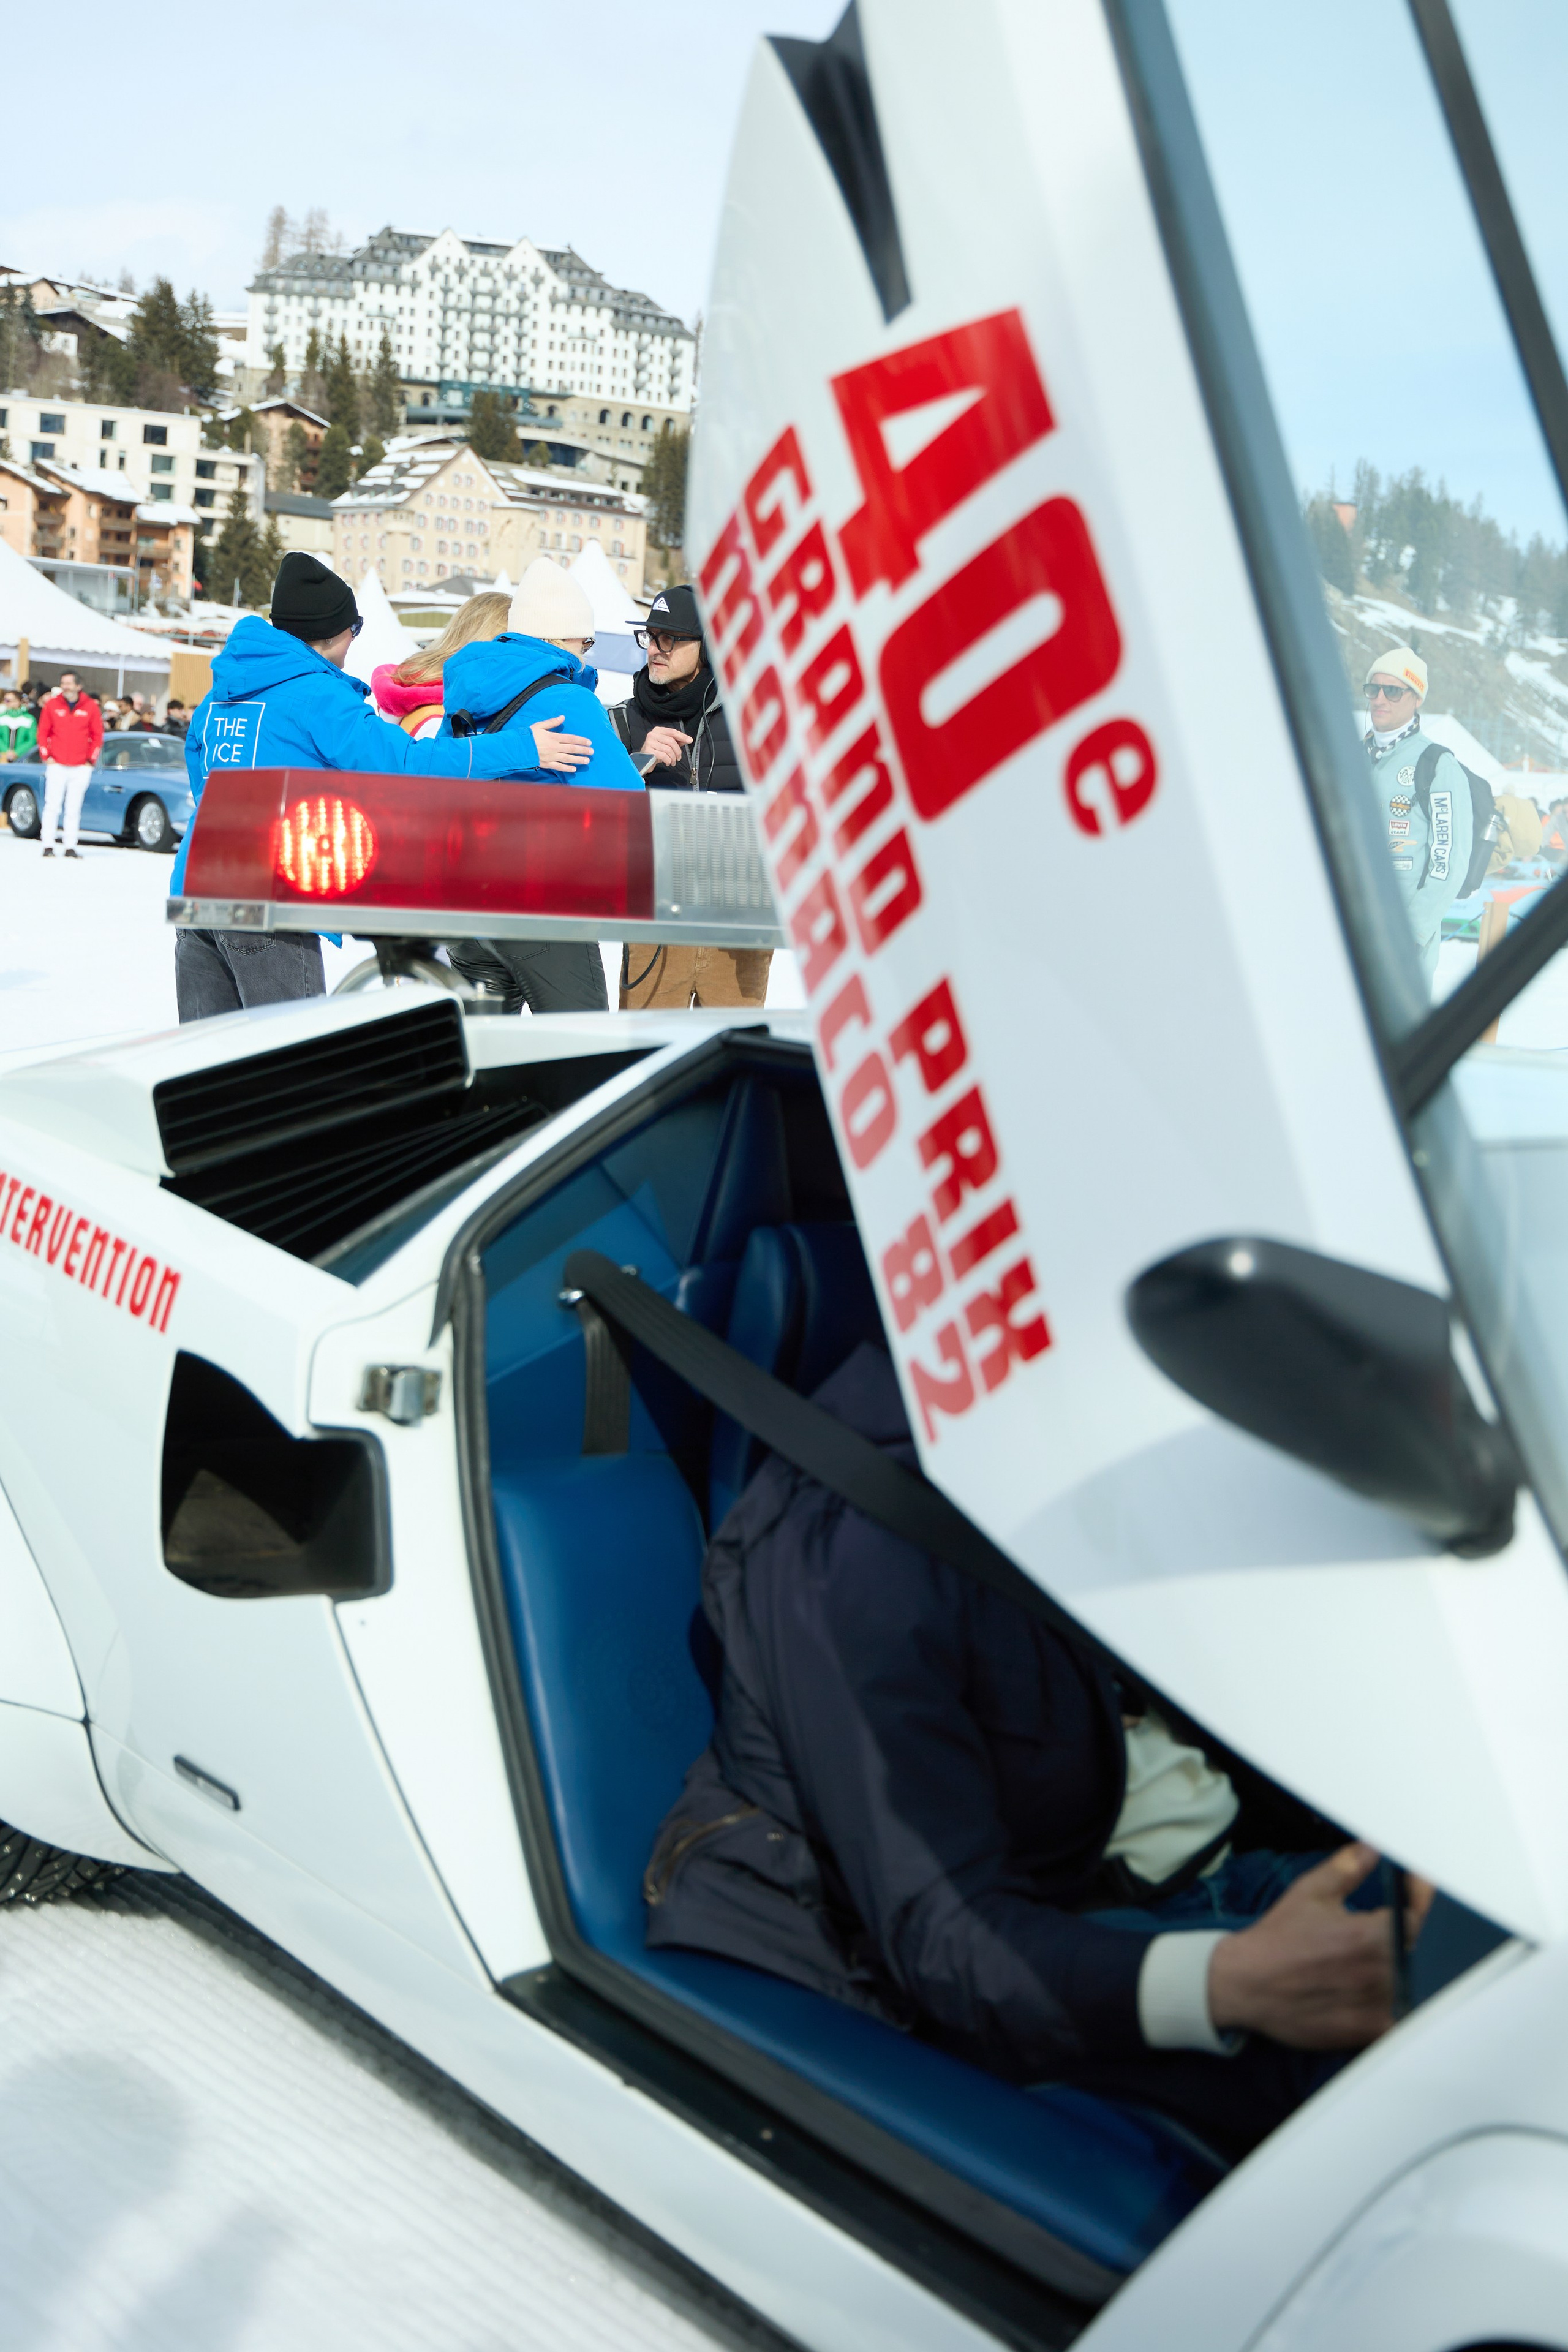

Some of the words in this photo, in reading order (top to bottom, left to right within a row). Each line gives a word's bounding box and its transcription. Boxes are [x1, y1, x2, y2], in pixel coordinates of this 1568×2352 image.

[214, 718, 248, 737] THE
[212, 742, 243, 763] ICE
[1434, 848, 1446, 874] CARS
[742, 424, 924, 956] GRAND
[888, 975, 1054, 1393] PRIX
[880, 1213, 977, 1443] 82
